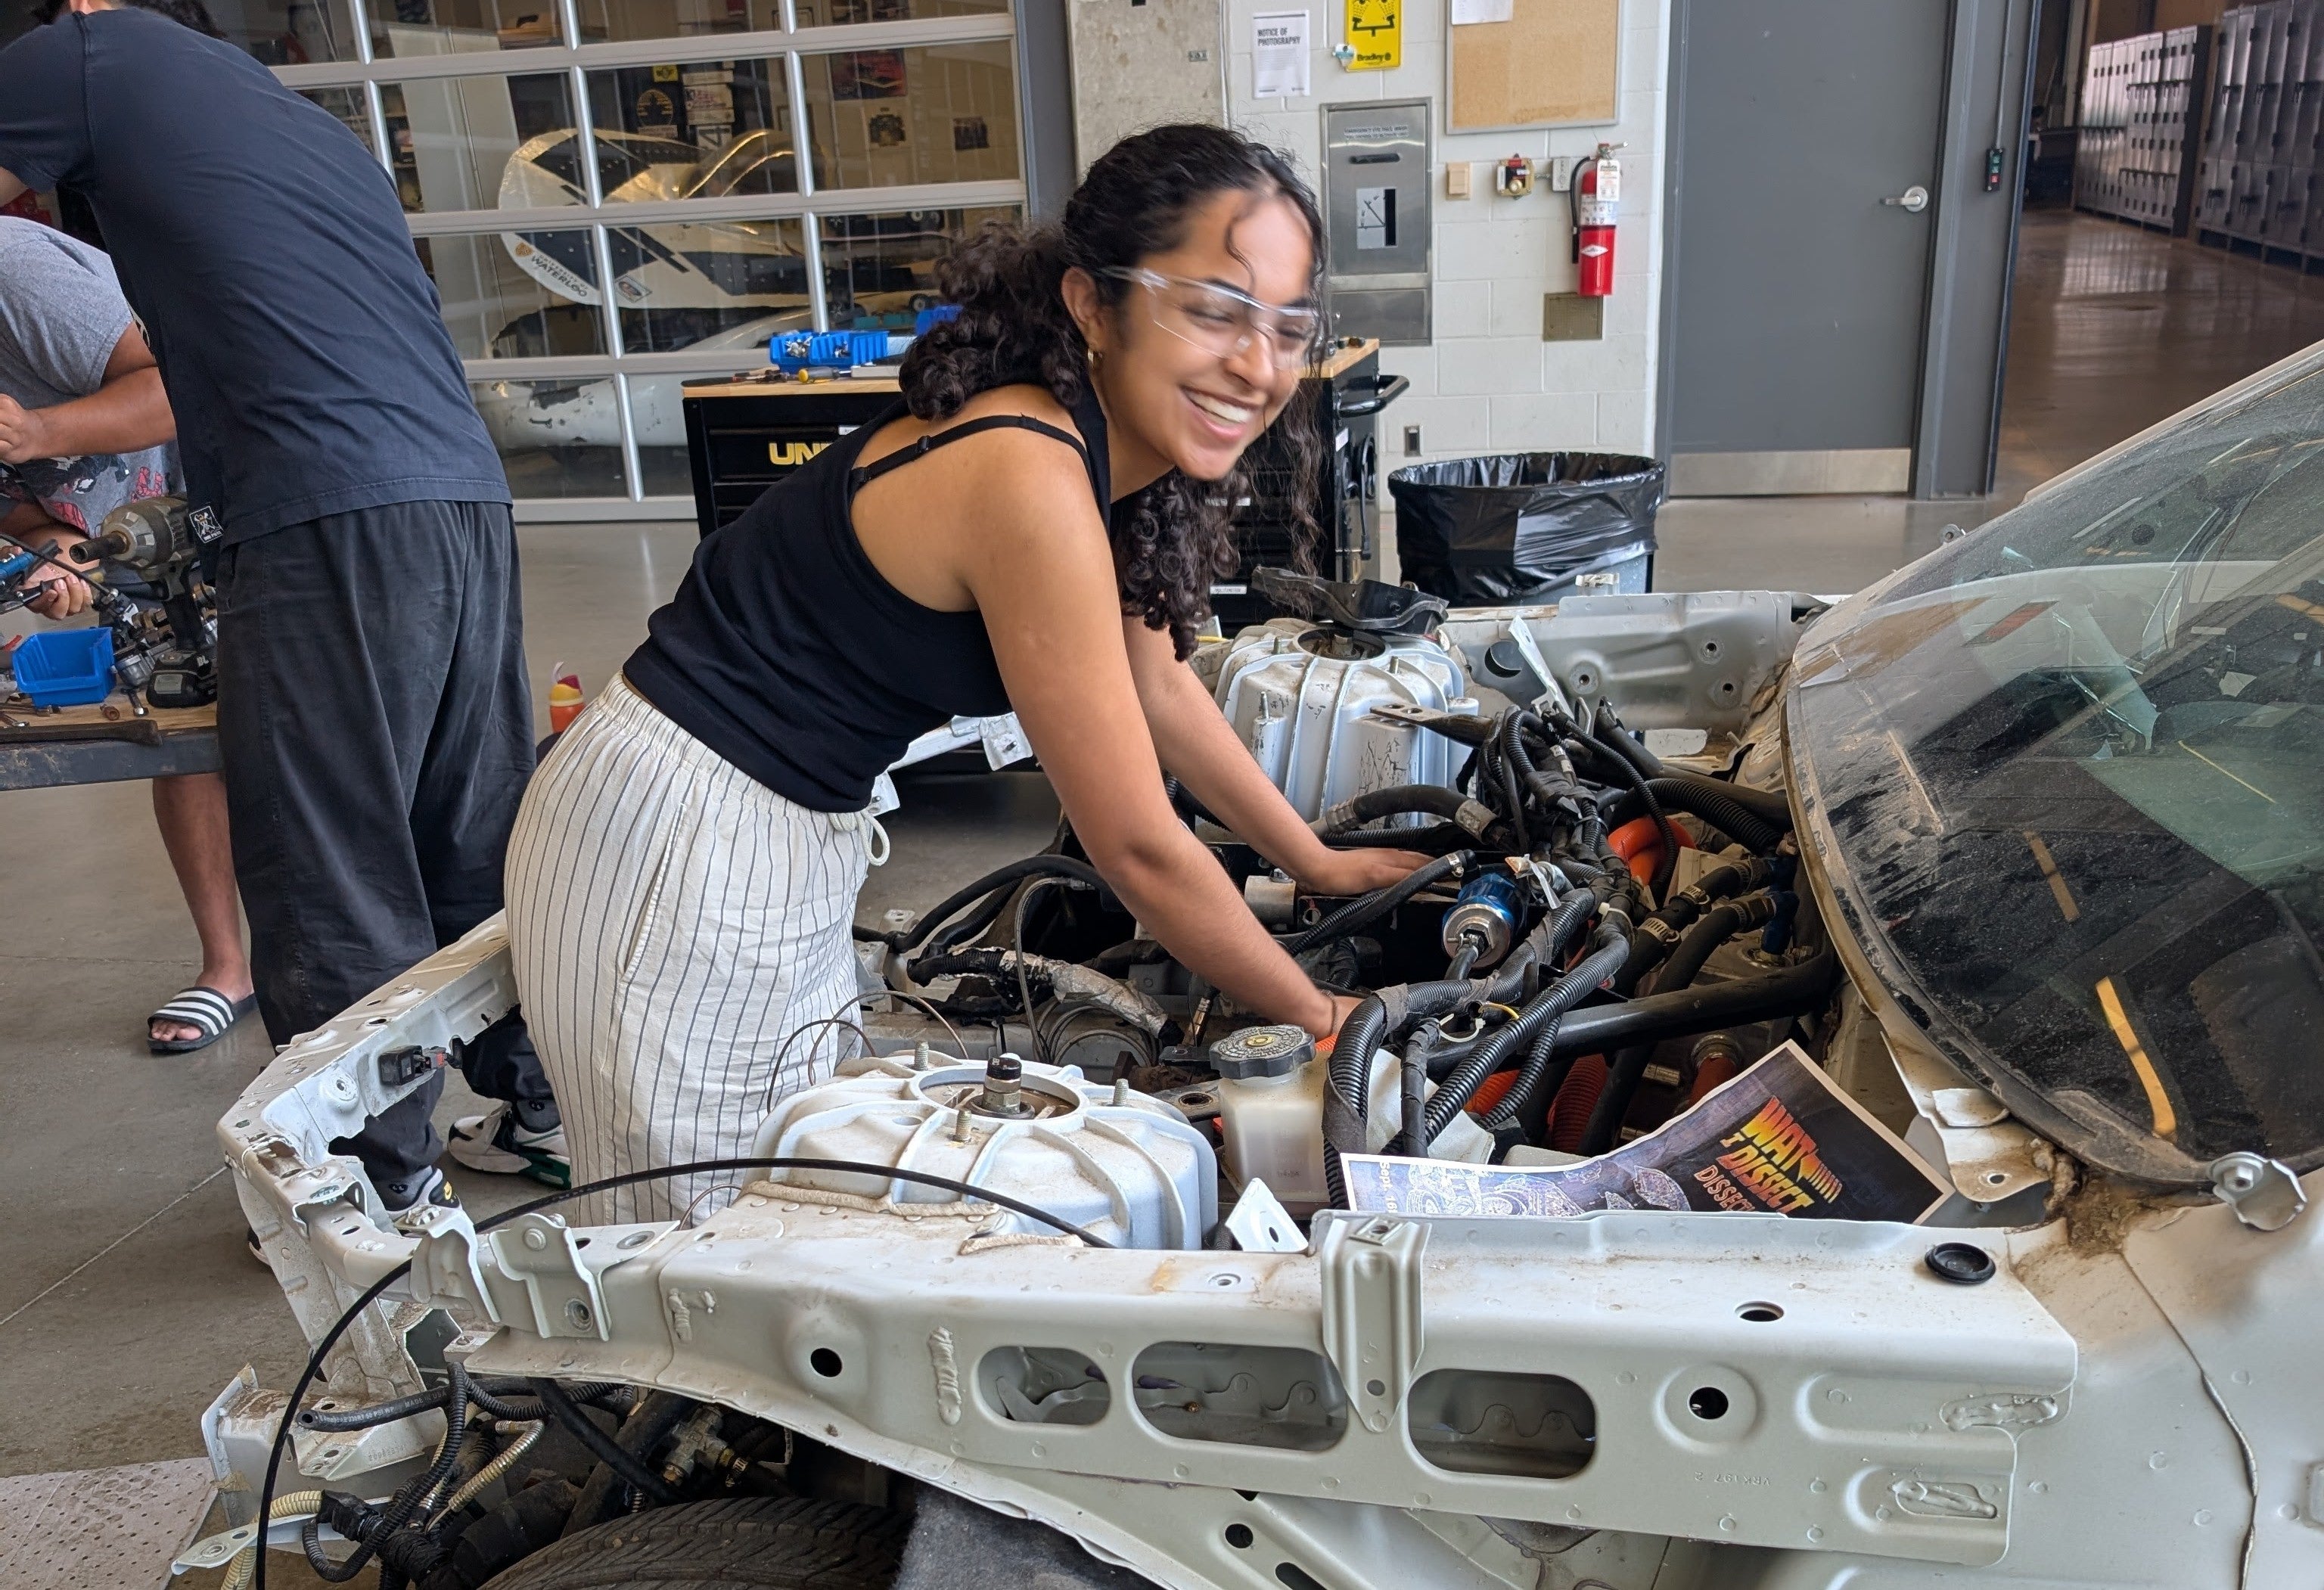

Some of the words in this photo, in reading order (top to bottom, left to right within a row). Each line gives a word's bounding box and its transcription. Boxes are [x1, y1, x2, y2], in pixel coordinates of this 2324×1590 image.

[1257, 28, 1278, 36] NOTICE
[1280, 27, 1288, 36] OF
[1257, 36, 1300, 45] PHOTOGRAPHY
[1357, 53, 1384, 62] Bradley
[531, 255, 588, 297] WATERLOO
[1720, 1132, 1746, 1148] I
[1741, 1095, 1817, 1173] WAT
[1715, 1144, 1816, 1215] DISSECT
[403, 1397, 424, 1408] MADE
